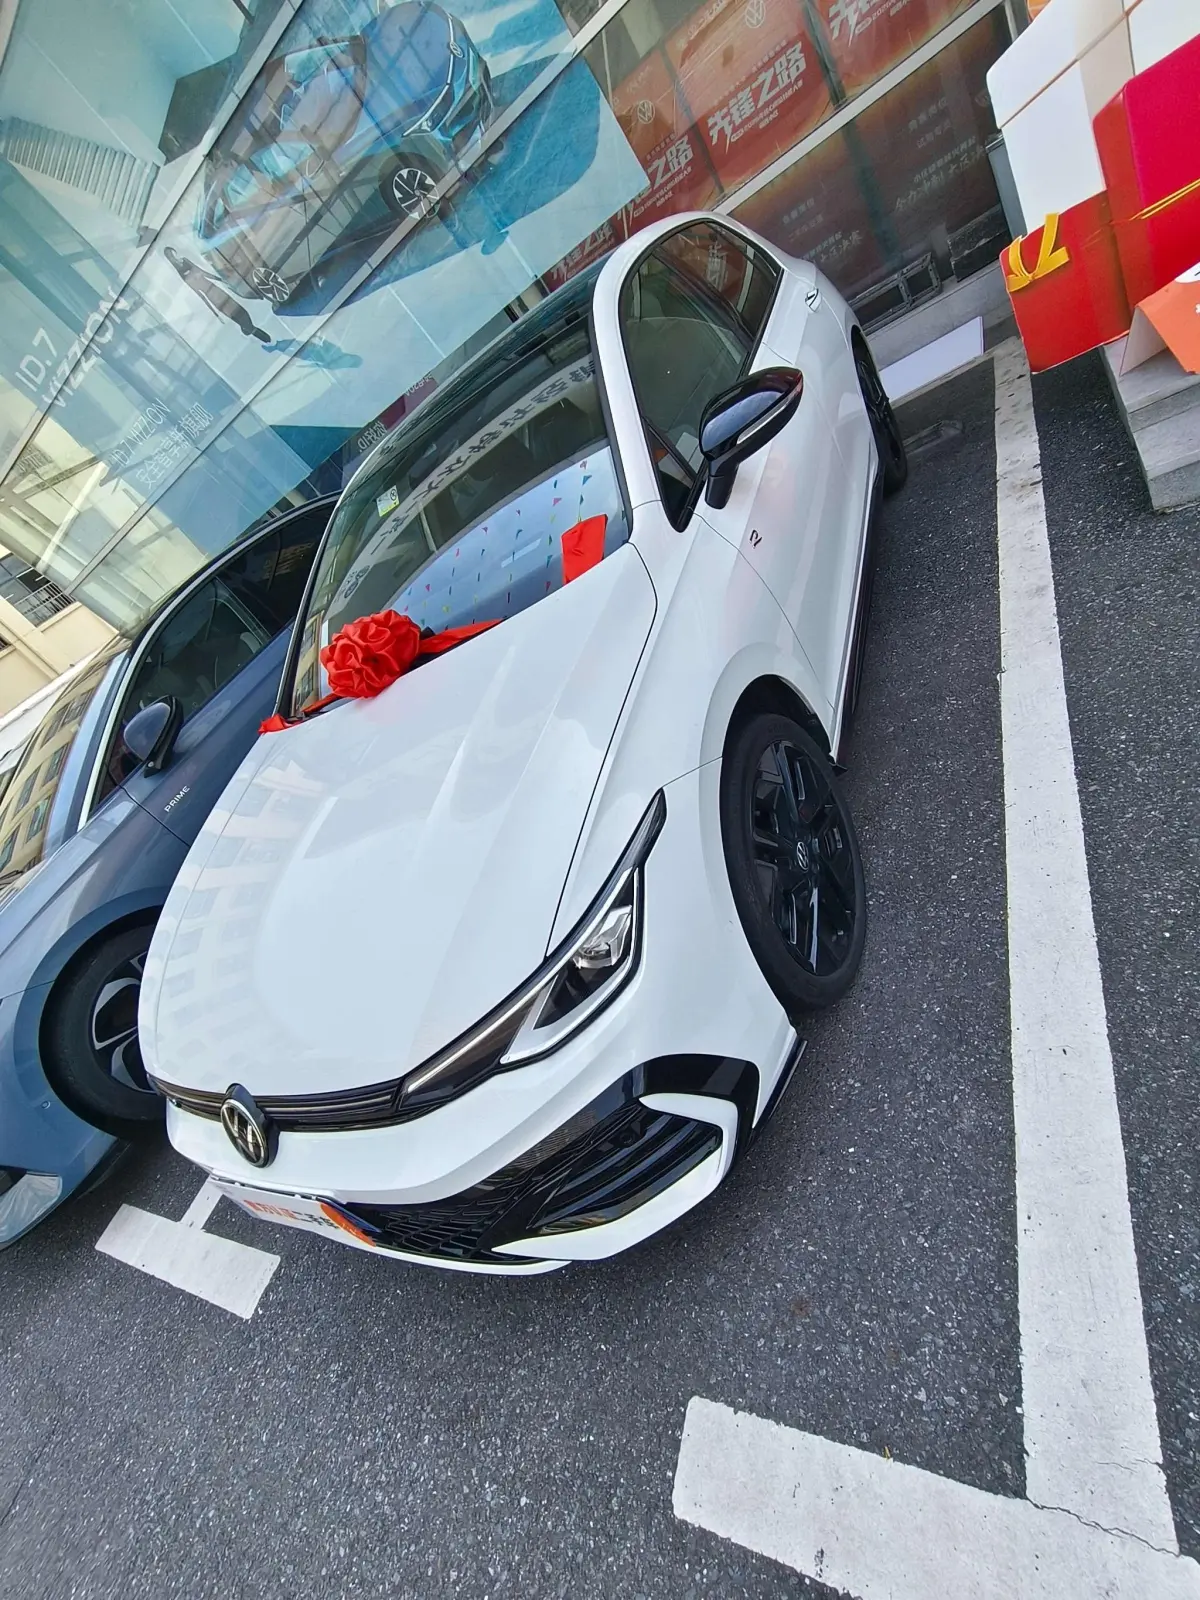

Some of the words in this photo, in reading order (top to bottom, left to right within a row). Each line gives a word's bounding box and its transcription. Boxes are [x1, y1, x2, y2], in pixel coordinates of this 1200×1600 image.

[707, 41, 807, 154] 先锋之路
[15, 327, 58, 392] ID.7
[42, 285, 130, 408] VIZZION
[129, 397, 172, 446] VIZZION
[164, 785, 190, 813] PRIME
